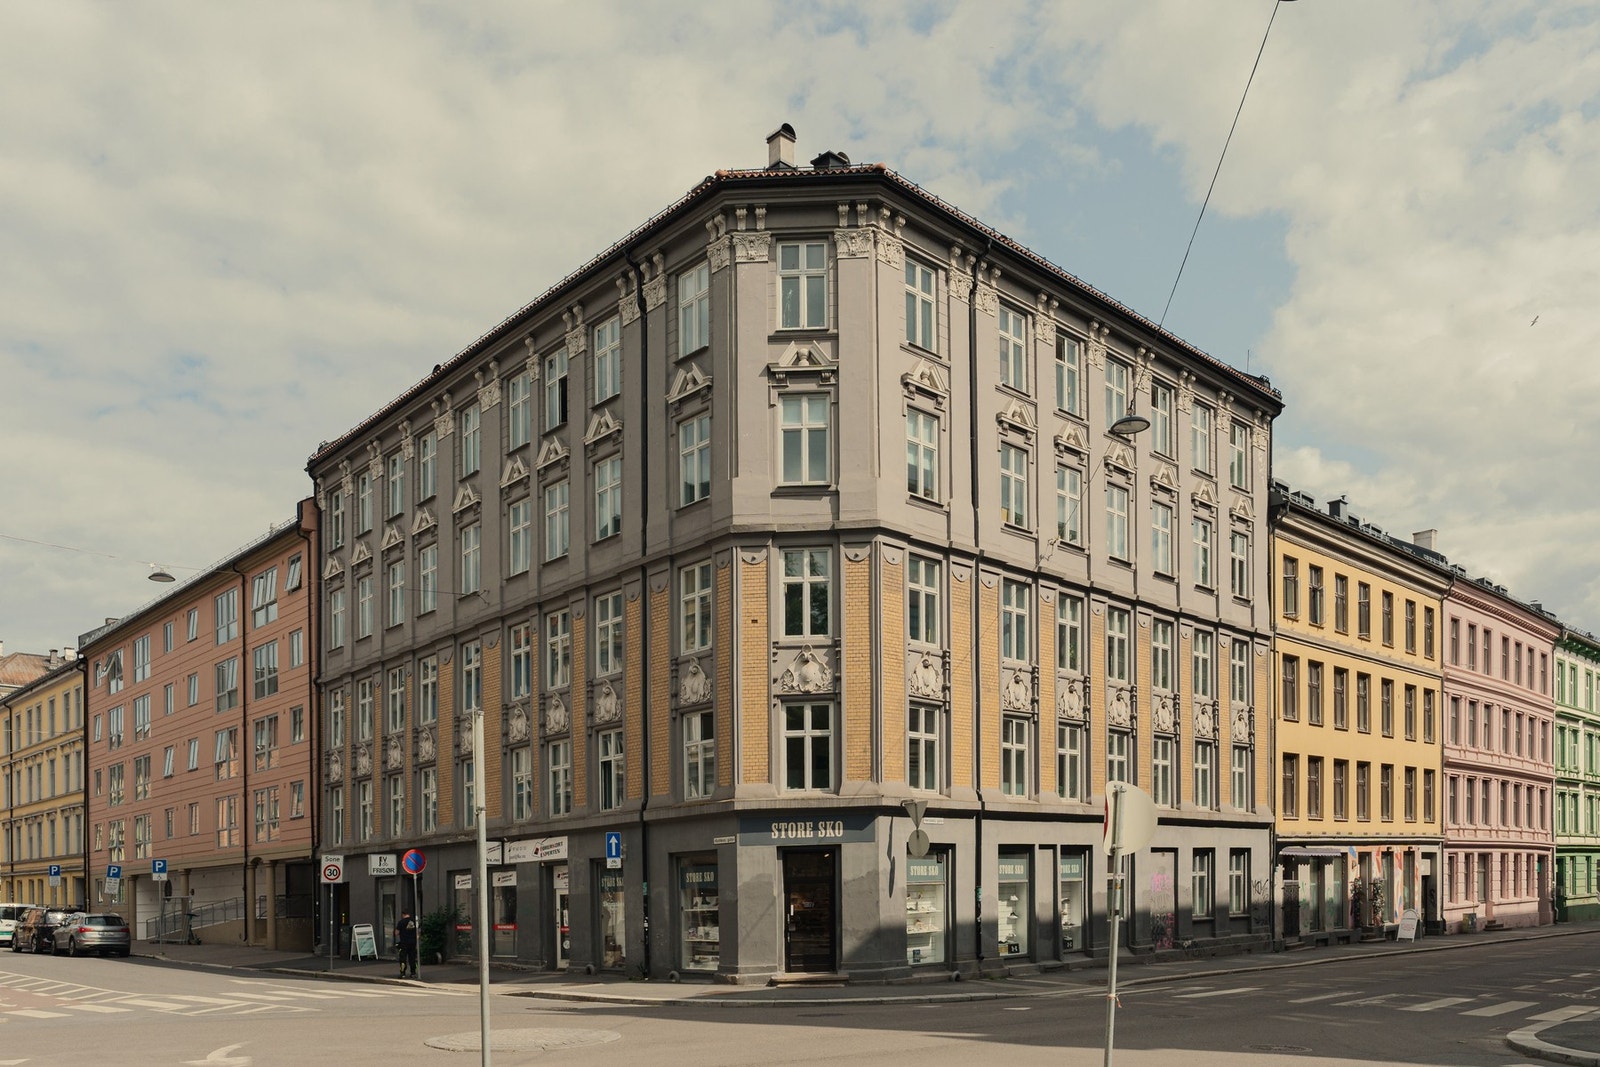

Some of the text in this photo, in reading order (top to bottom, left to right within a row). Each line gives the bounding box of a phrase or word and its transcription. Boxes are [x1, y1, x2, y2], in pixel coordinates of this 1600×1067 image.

[771, 821, 844, 839] STORE SKO
[51, 866, 58, 875] P
[110, 867, 118, 876] P
[155, 861, 163, 872] P
[910, 865, 939, 876] STORE SKO
[999, 864, 1024, 875] STORE SKO
[1060, 864, 1079, 874] TORE SKO
[326, 868, 338, 877] 30
[686, 871, 715, 883] STORE SKO
